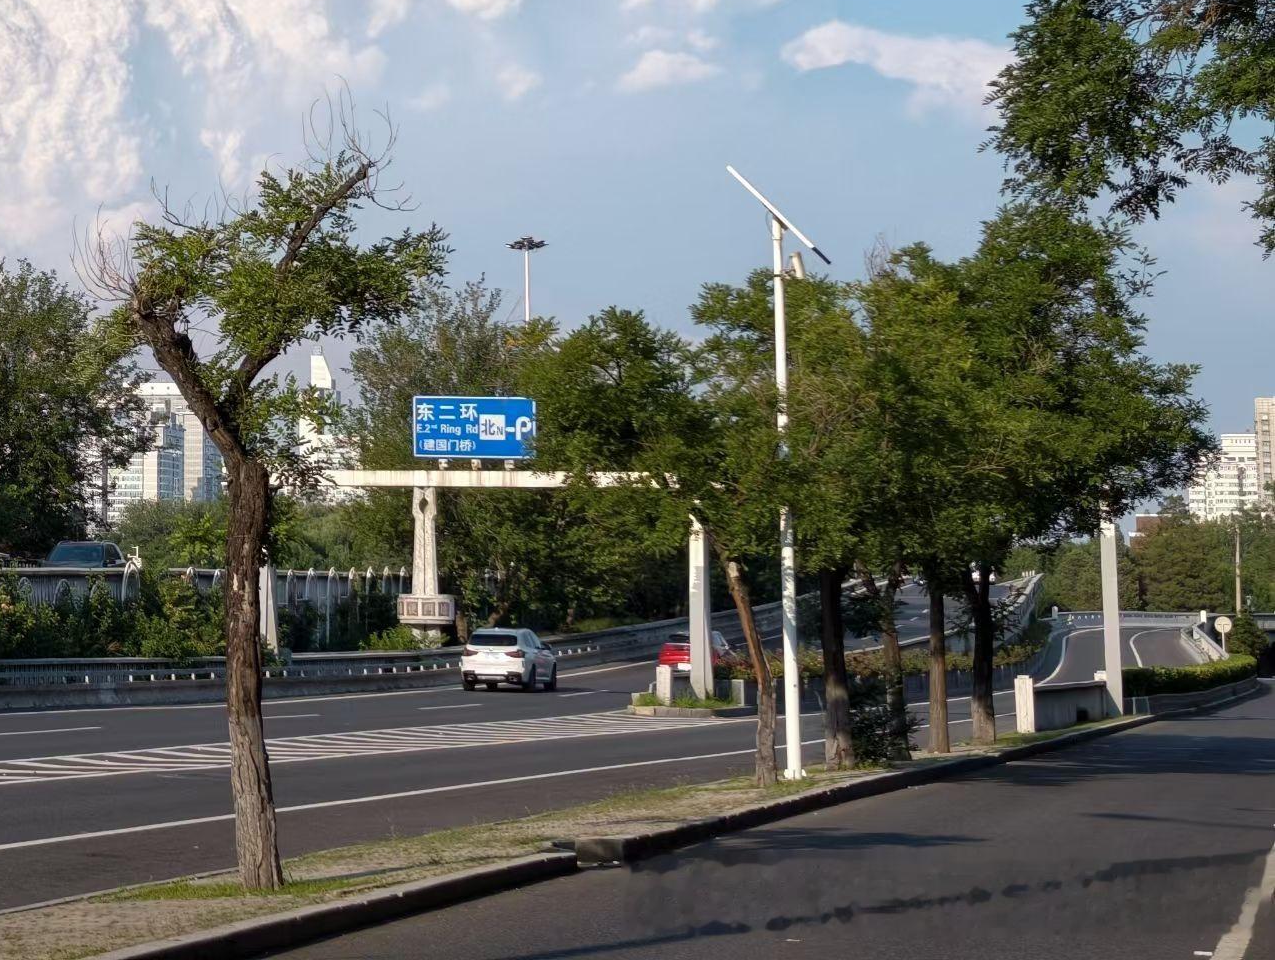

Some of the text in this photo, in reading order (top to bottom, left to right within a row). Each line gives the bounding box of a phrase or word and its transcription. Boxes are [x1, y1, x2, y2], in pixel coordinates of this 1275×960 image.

[416, 403, 478, 422] 东二环
[440, 423, 462, 436] Ring
[465, 423, 478, 434] Rd
[481, 419, 496, 436] 北
